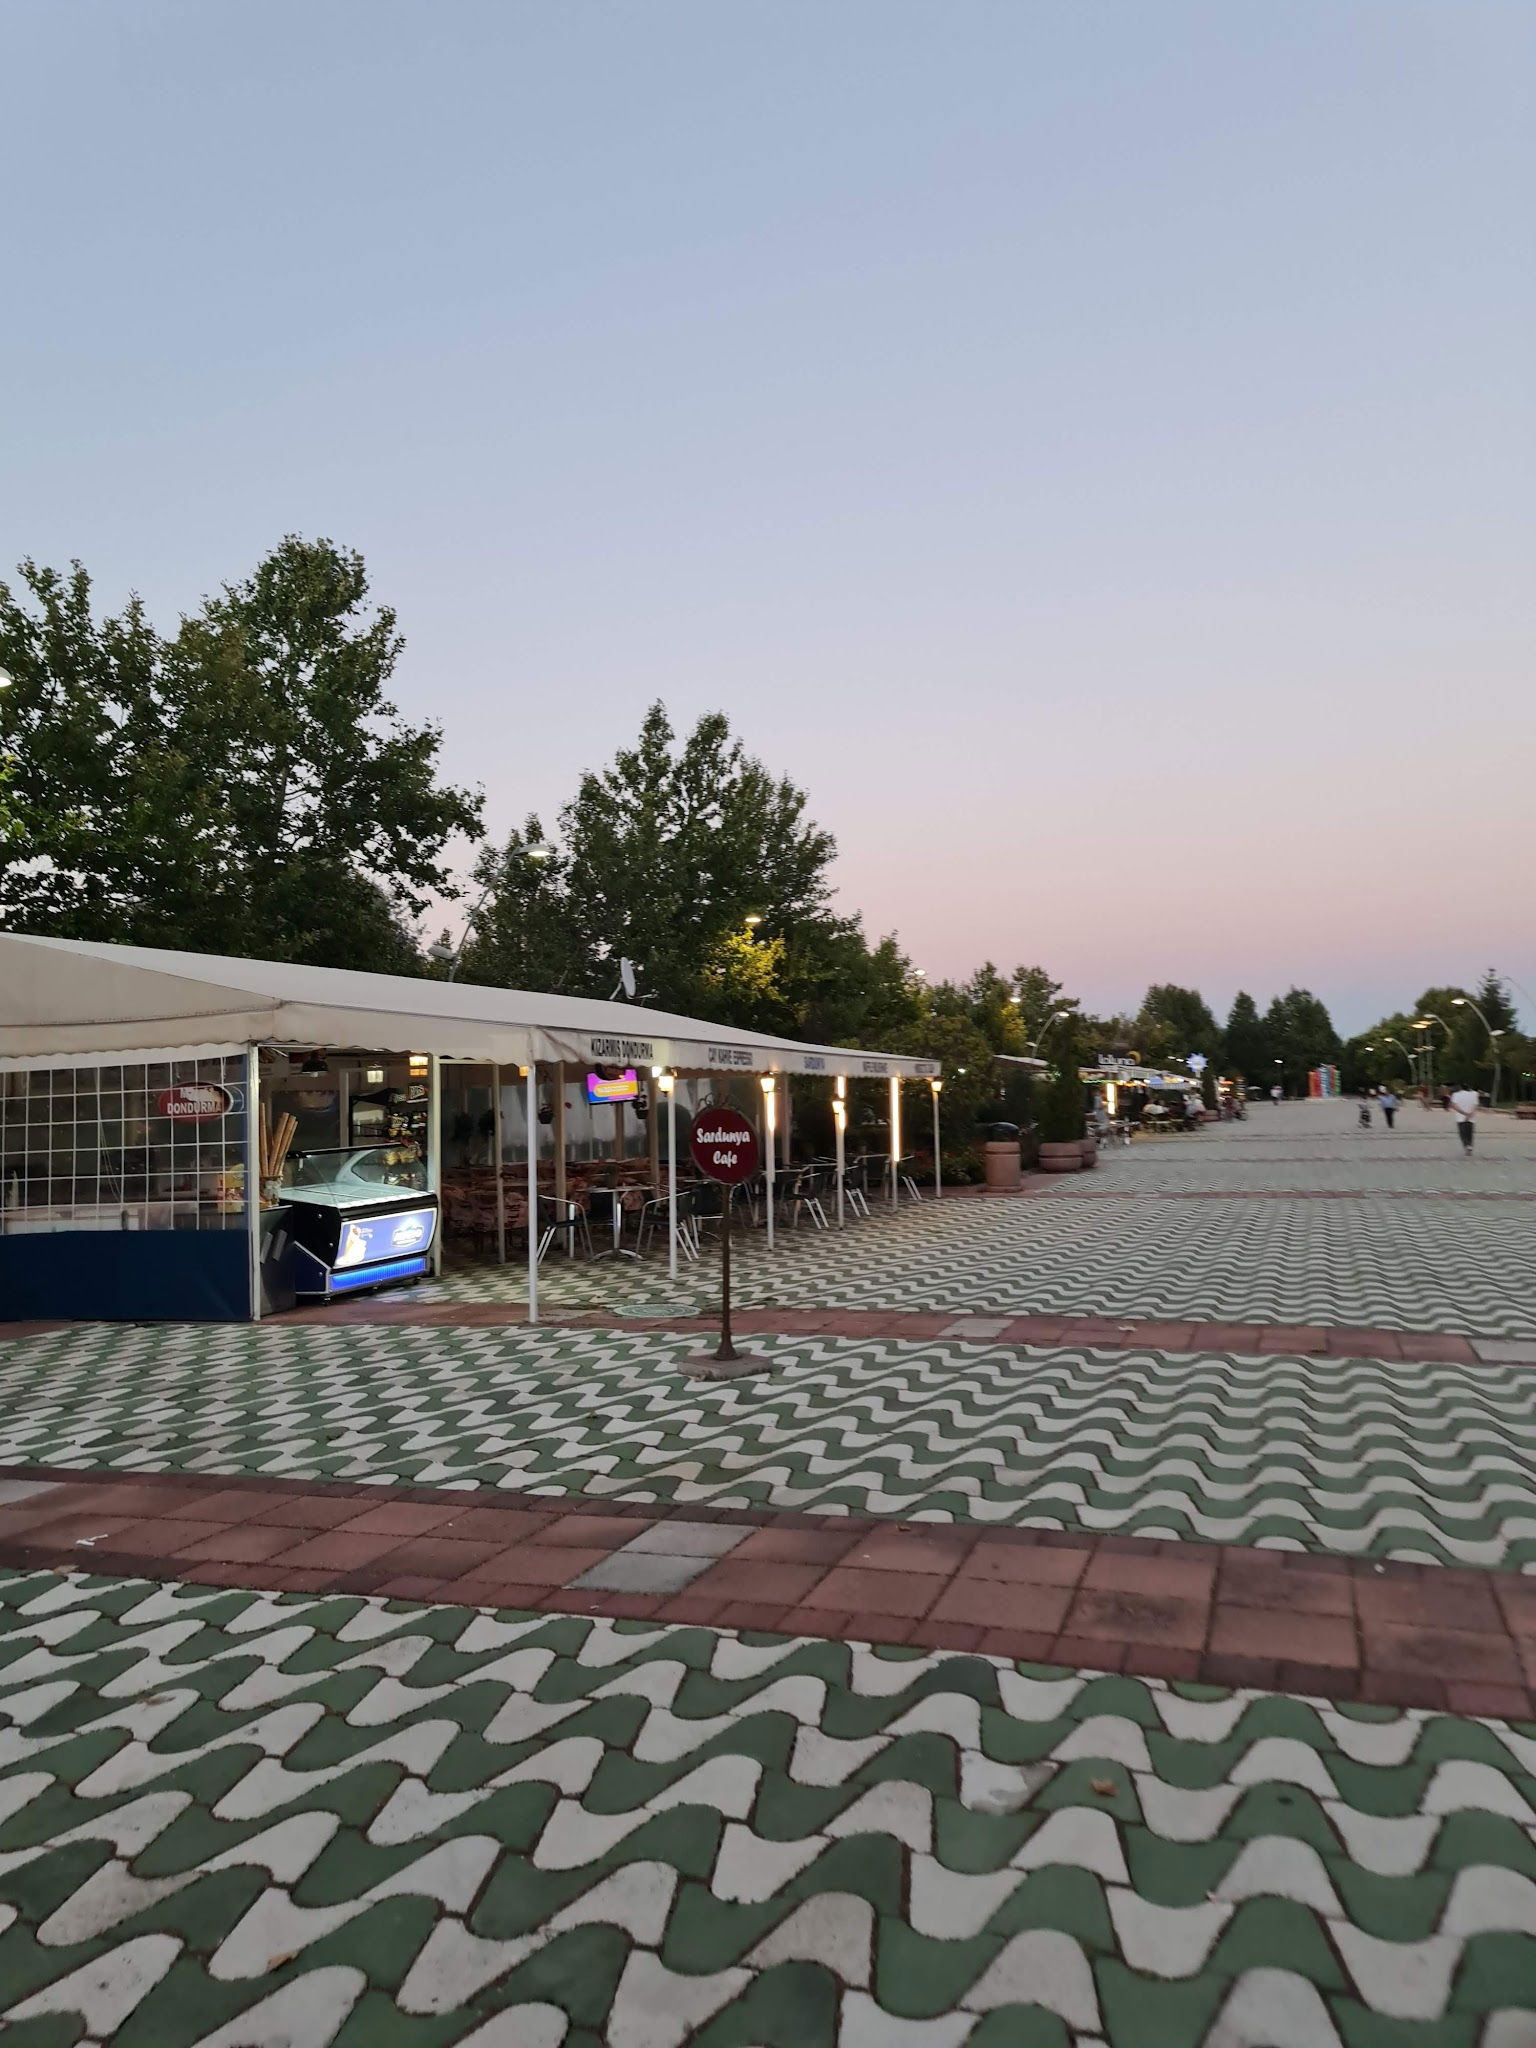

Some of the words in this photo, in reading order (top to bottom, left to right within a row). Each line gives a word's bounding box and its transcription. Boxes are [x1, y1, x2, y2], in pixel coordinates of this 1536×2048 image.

[622, 1040, 654, 1060] DONDURMA
[167, 1101, 222, 1115] DONDURMA
[696, 1127, 751, 1146] Sardunya
[713, 1150, 738, 1168] Cafe
